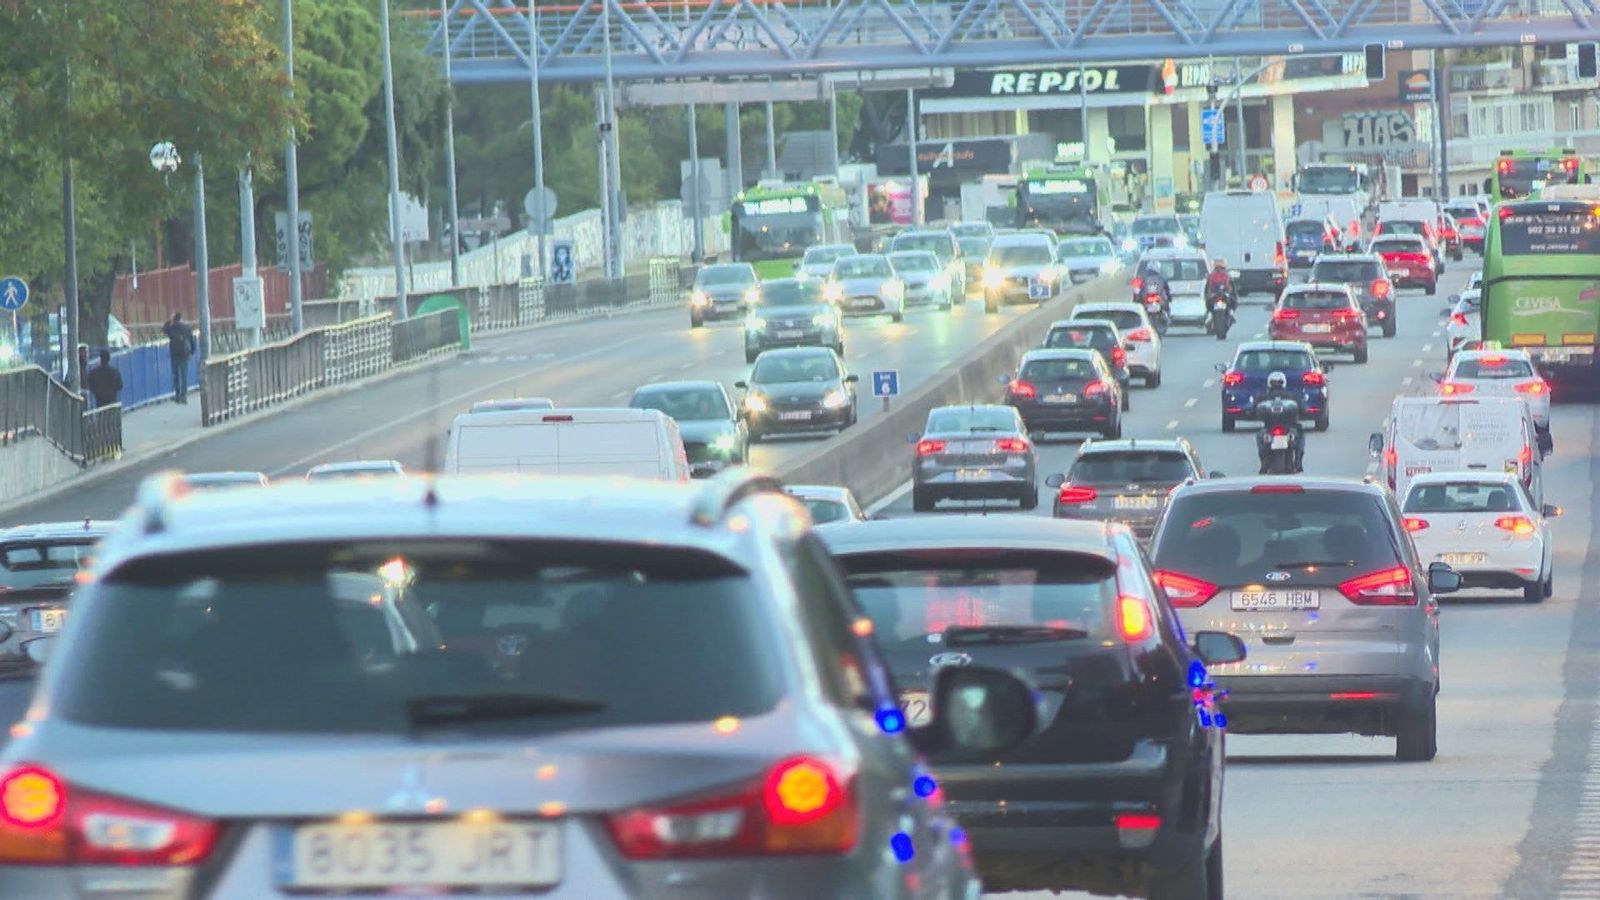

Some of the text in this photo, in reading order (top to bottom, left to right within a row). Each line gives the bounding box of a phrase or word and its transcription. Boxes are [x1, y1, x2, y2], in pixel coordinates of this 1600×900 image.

[990, 69, 1120, 95] REPSOL
[1515, 296, 1561, 309] CEVESA
[1241, 592, 1312, 606] 6546 HBM
[306, 827, 549, 877] 8035 JRT
